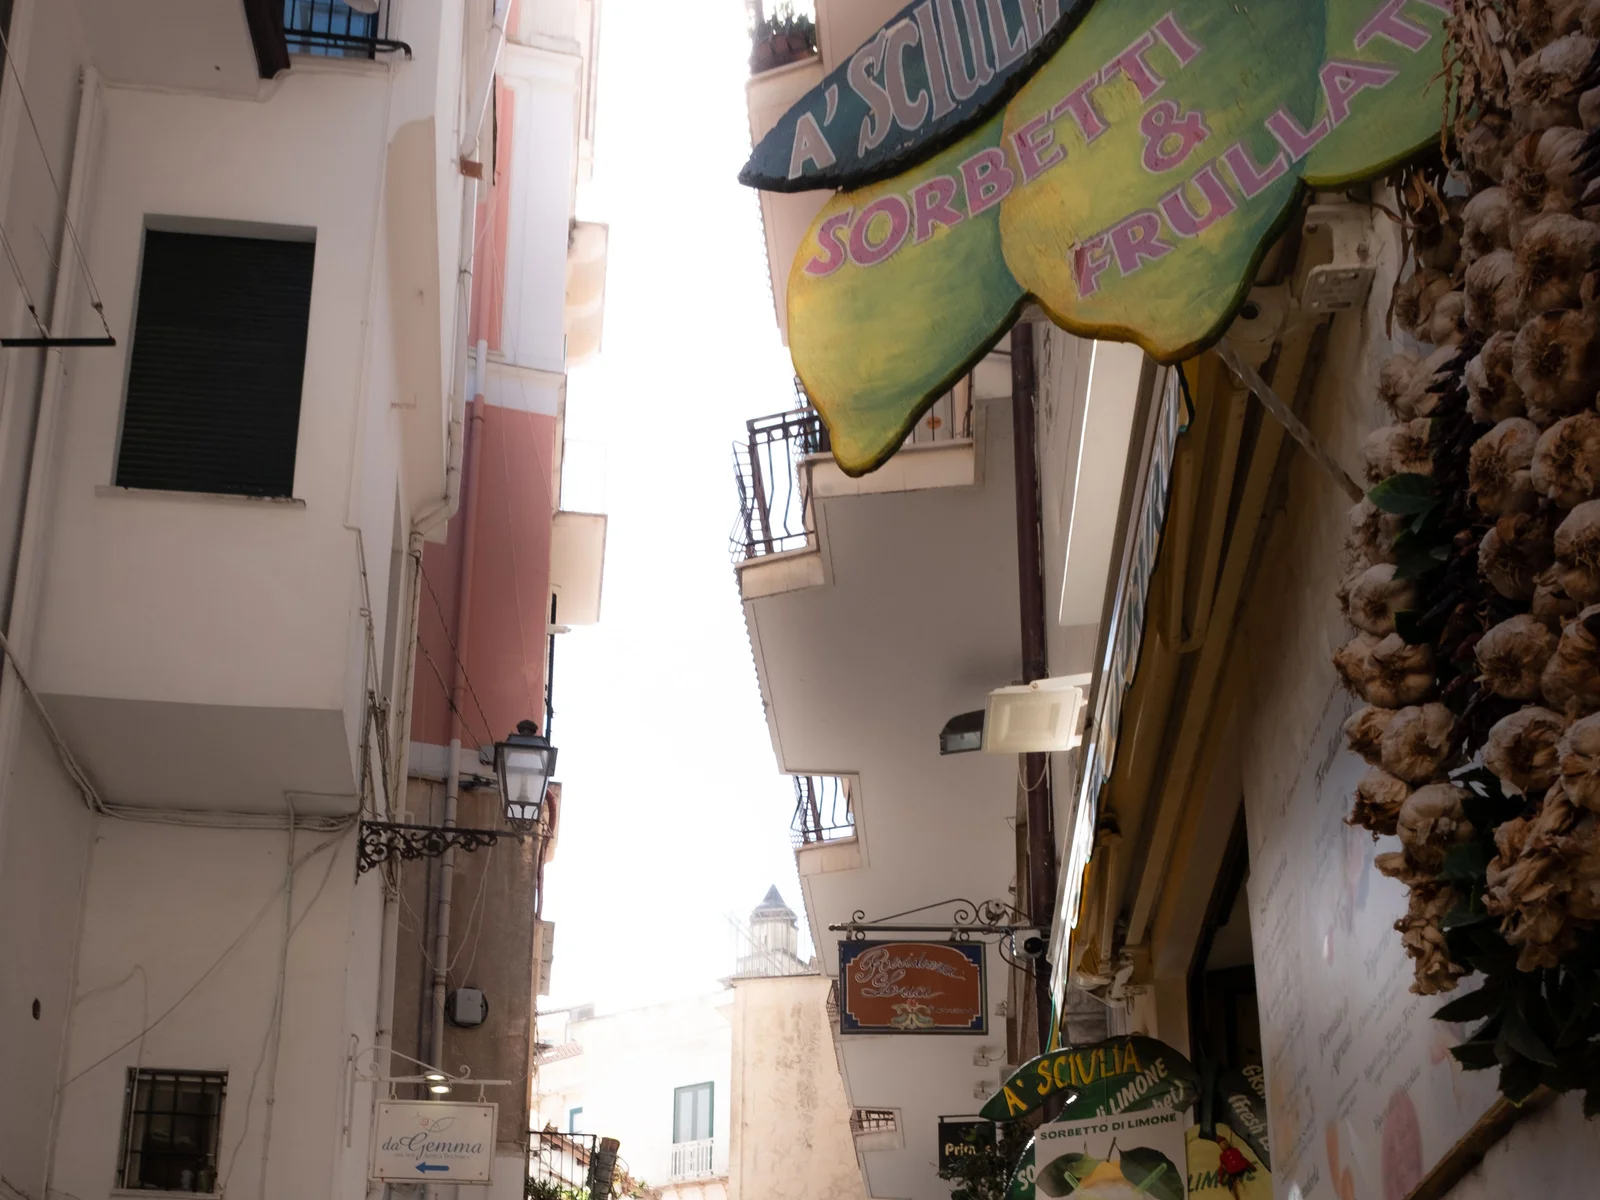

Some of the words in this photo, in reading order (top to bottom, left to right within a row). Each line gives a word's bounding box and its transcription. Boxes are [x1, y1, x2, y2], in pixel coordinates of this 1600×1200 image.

[804, 12, 1201, 277] SORBETTI
[1140, 101, 1207, 174] &
[1109, 1057, 1169, 1114] LIMONE
[399, 1132, 485, 1160] Gemma
[1040, 1123, 1108, 1140] SORBETTO
[1112, 1121, 1125, 1132] DI
[1128, 1113, 1177, 1128] LIMONE
